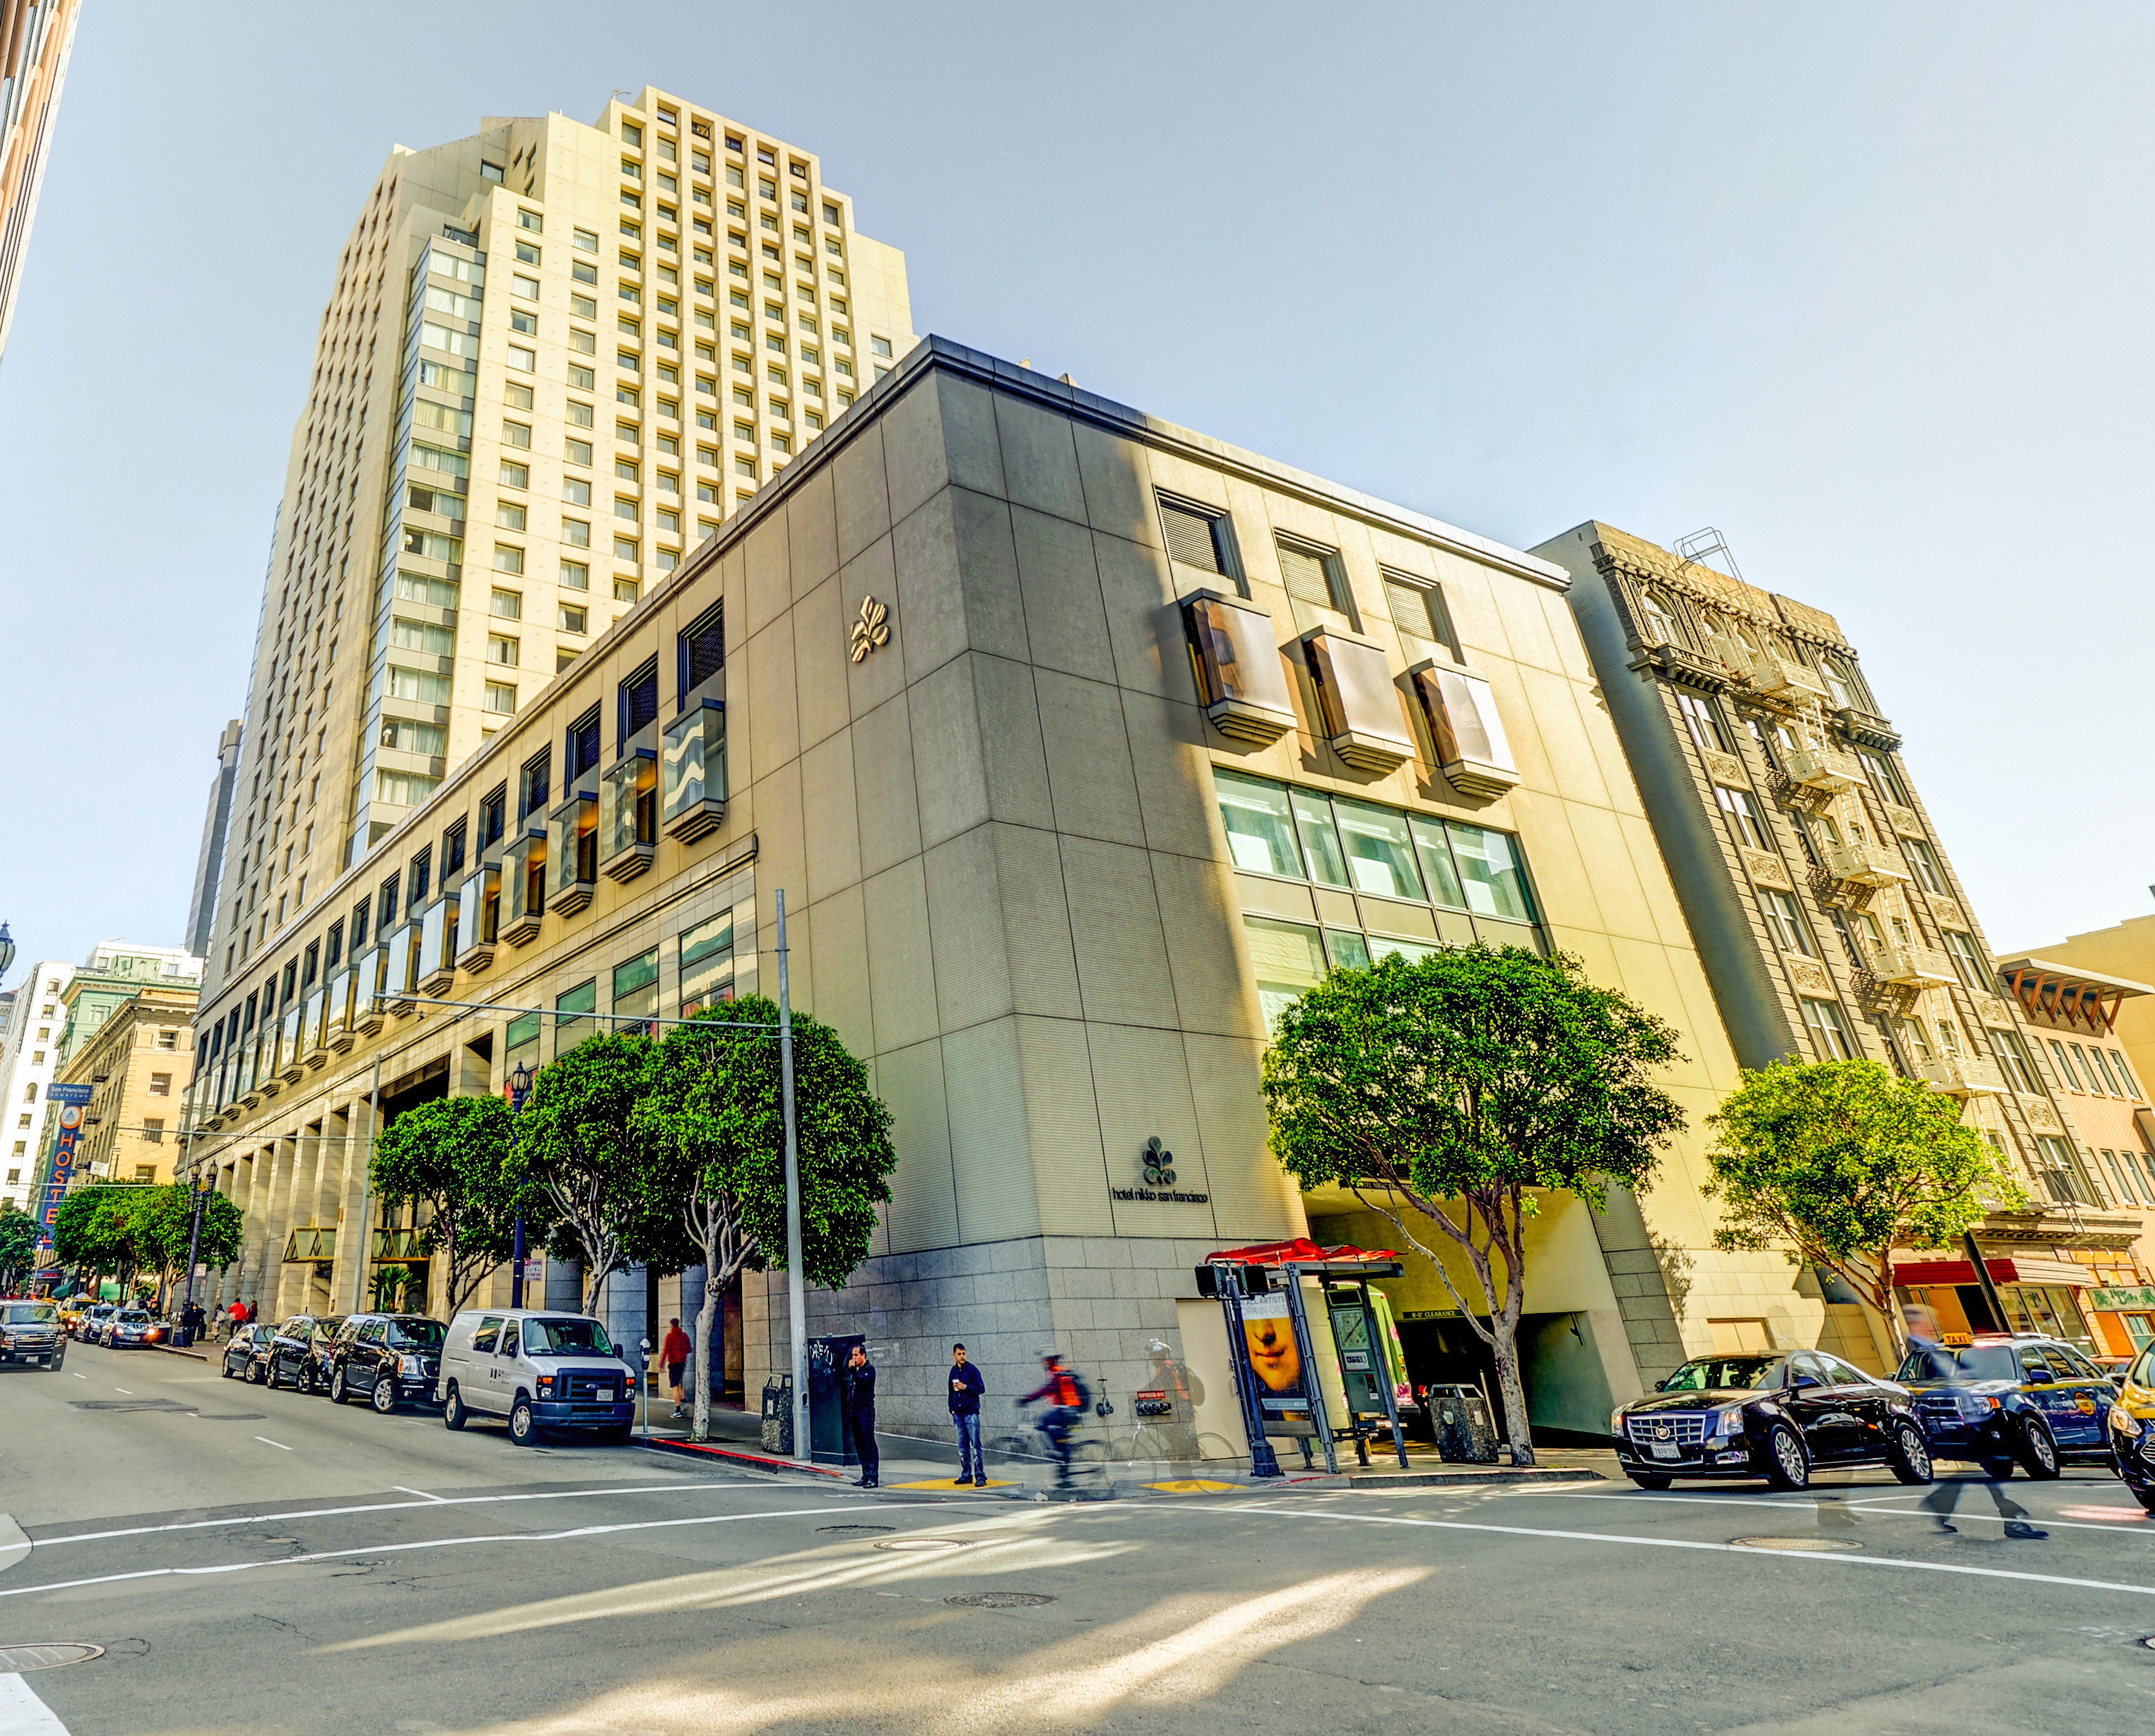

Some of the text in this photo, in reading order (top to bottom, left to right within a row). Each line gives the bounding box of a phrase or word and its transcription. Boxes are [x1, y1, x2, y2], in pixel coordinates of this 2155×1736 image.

[1112, 1187, 1209, 1203] hotel nikko san francisco
[1259, 1296, 1285, 1304] ARTISTS
[1241, 1307, 1258, 1316] ORK
[1269, 1304, 1287, 1314] OILS
